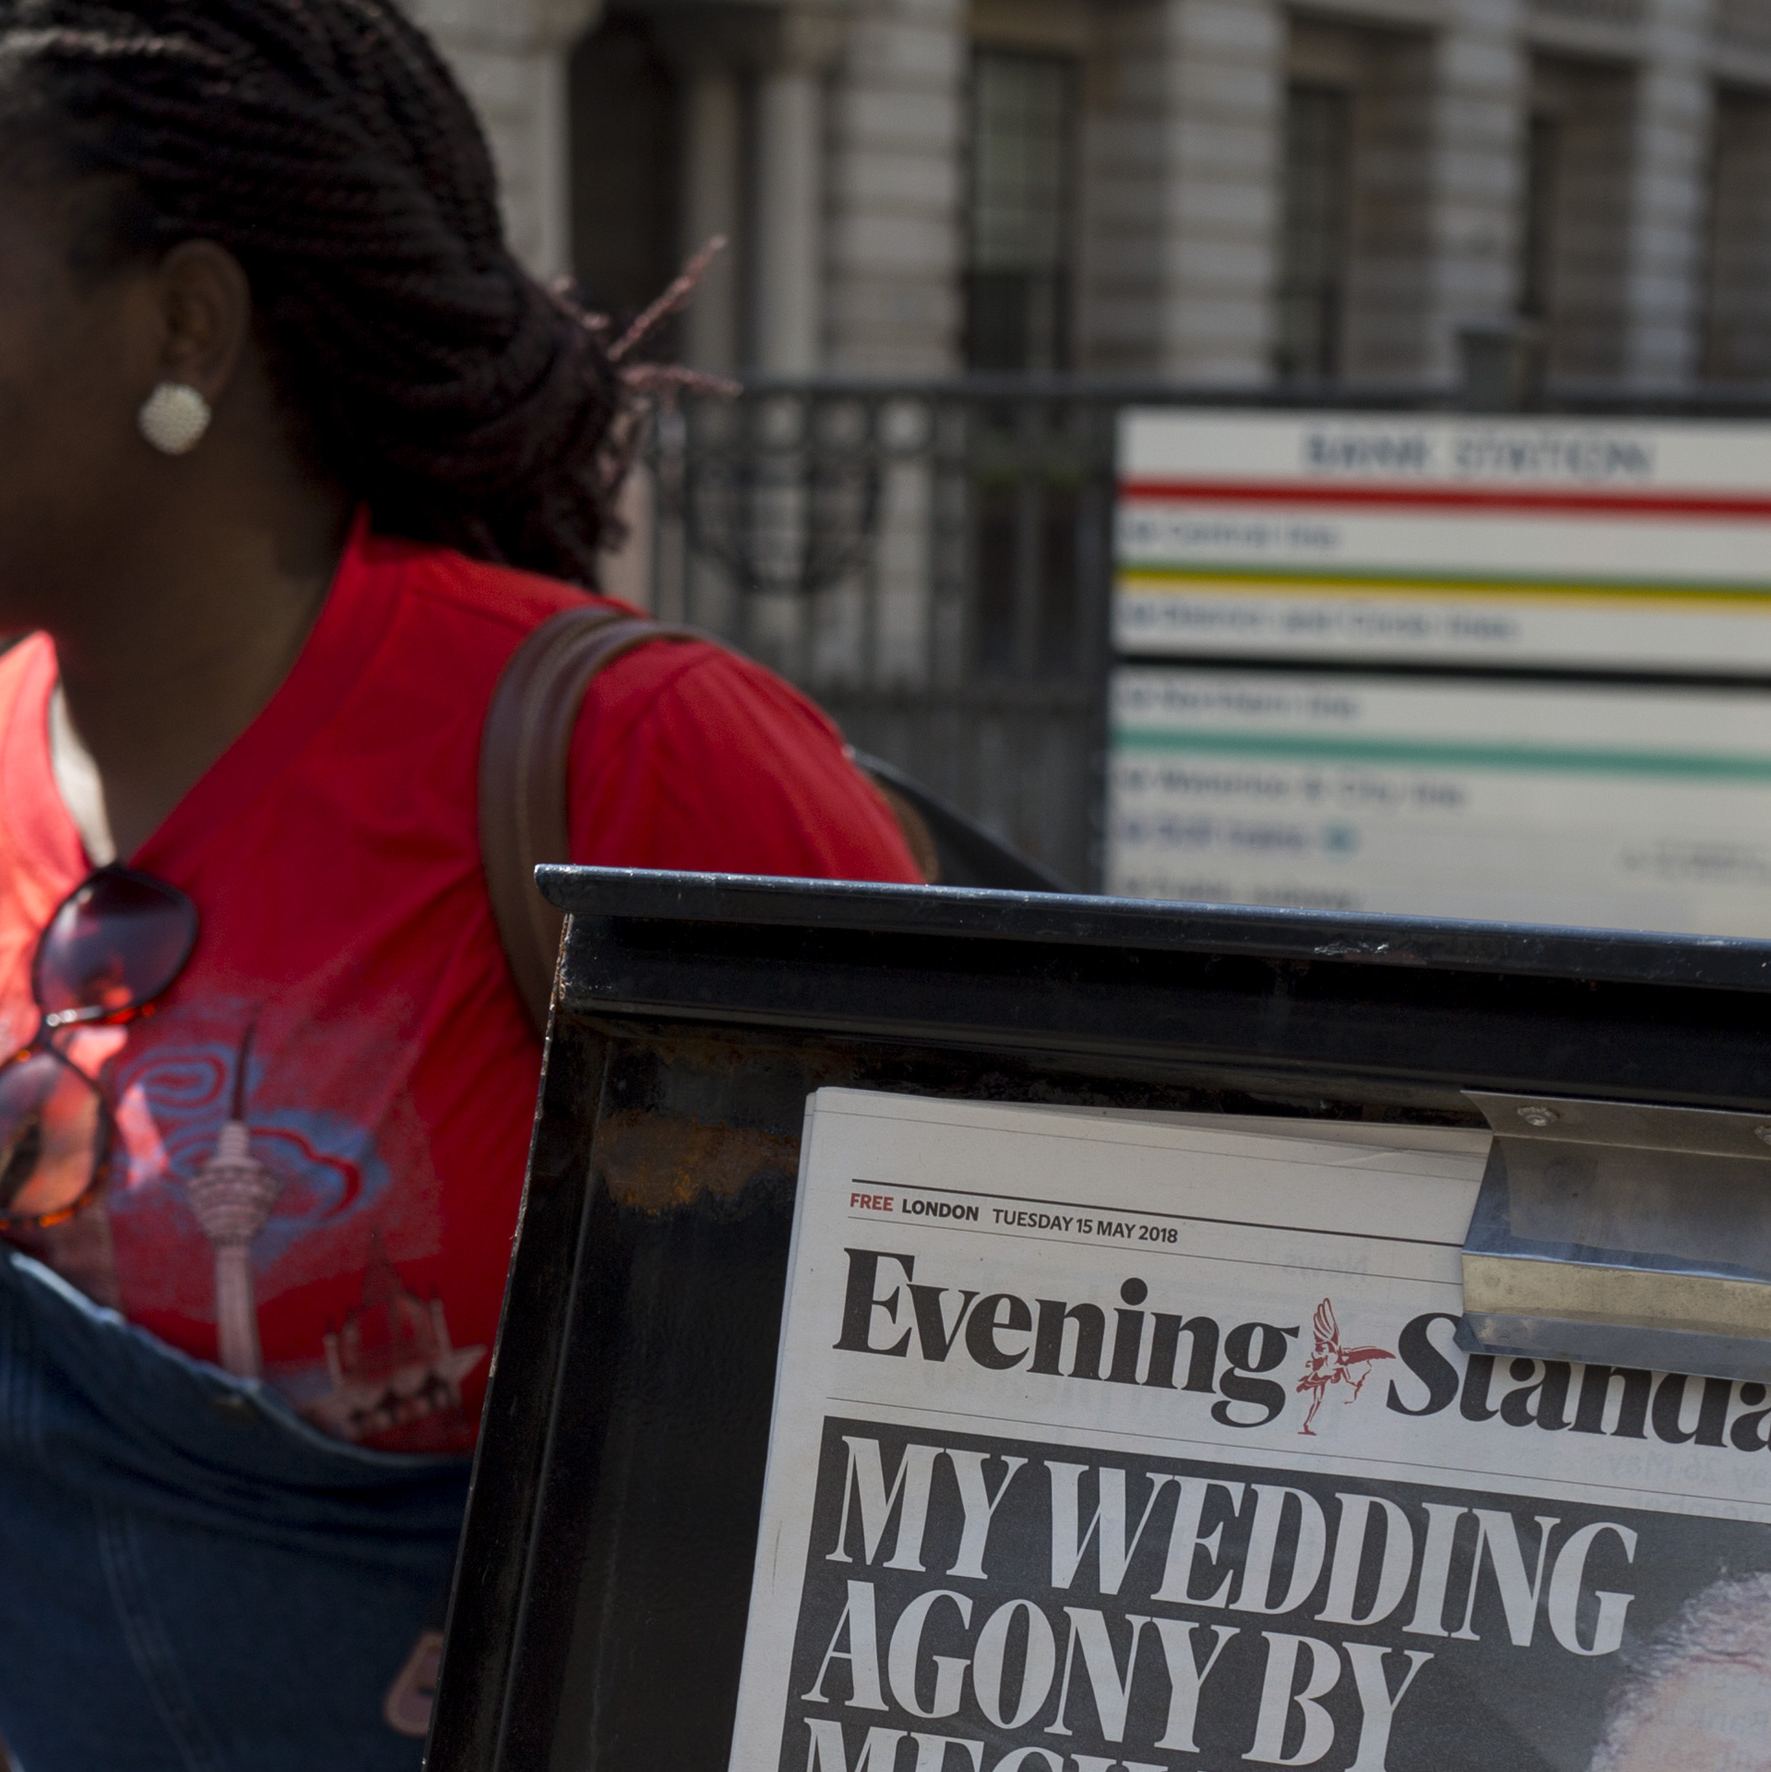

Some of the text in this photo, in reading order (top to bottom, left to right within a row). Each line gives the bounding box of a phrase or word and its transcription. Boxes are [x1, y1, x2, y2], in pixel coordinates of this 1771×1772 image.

[850, 1193, 1178, 1243] FREE LONDON TUESDAY 15 MAY 2018
[832, 1245, 1299, 1428] Evening
[826, 1435, 1638, 1657] MY WEDDING
[801, 1580, 1241, 1755] AGONY
